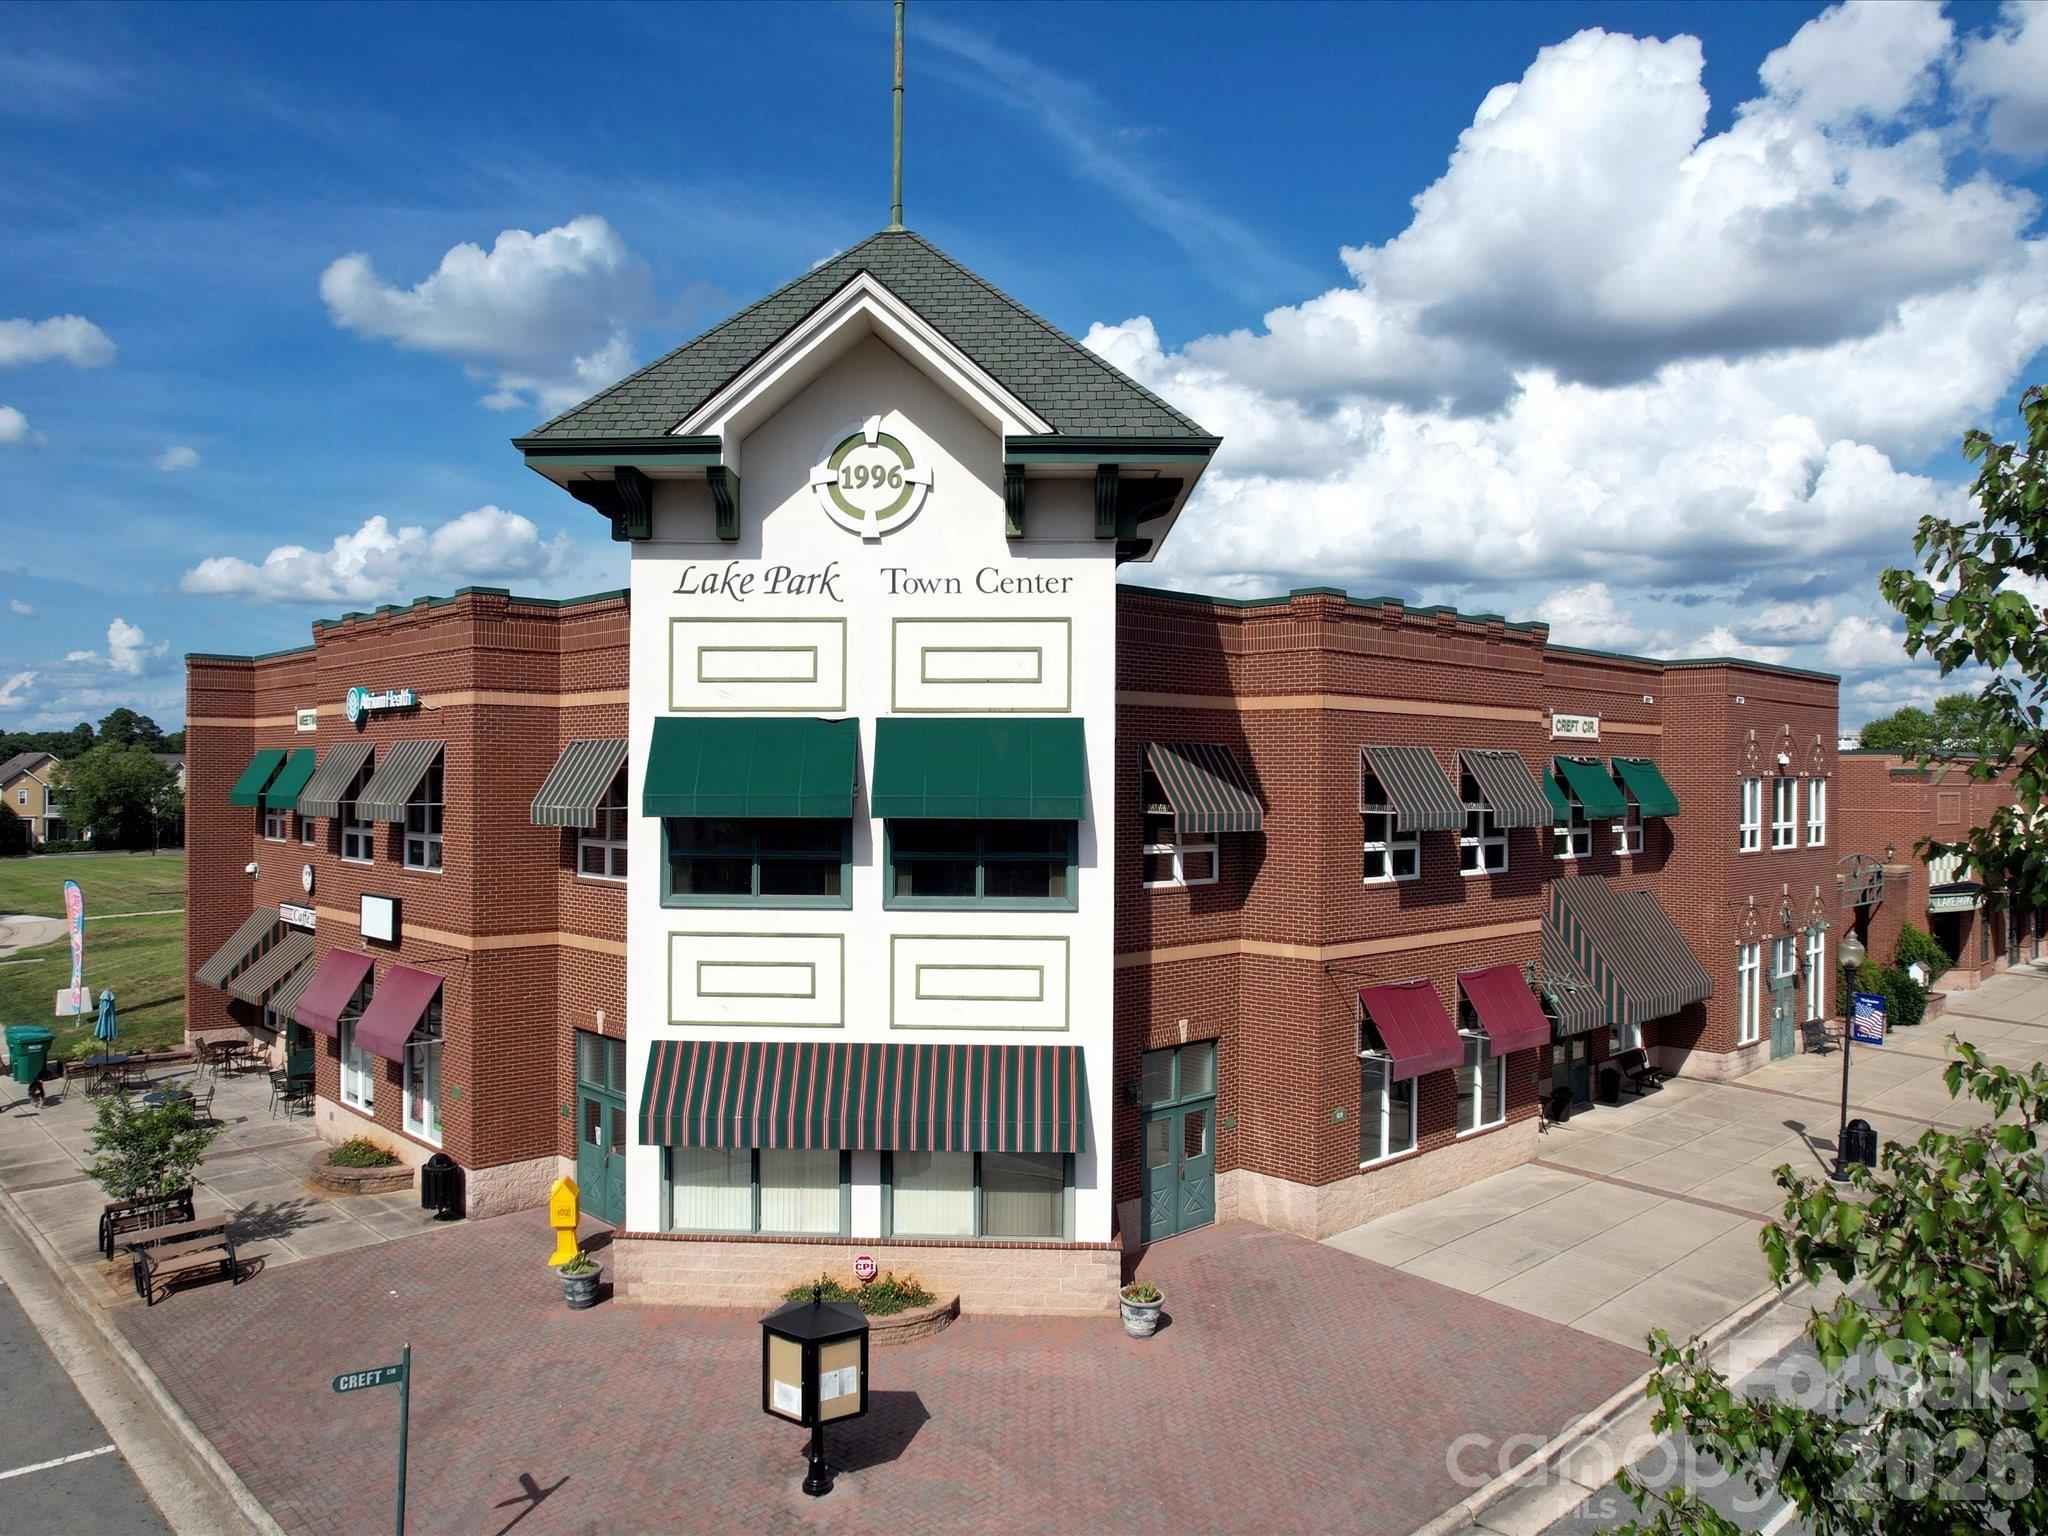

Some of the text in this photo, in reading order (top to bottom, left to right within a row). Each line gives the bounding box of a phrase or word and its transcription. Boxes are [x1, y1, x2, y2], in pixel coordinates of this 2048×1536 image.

[841, 464, 903, 490] 1996
[672, 560, 1074, 602] Lake Park Town Center
[1556, 718, 1579, 733] CREFT
[855, 1263, 874, 1271] CPI
[339, 1370, 383, 1391] CREFT
